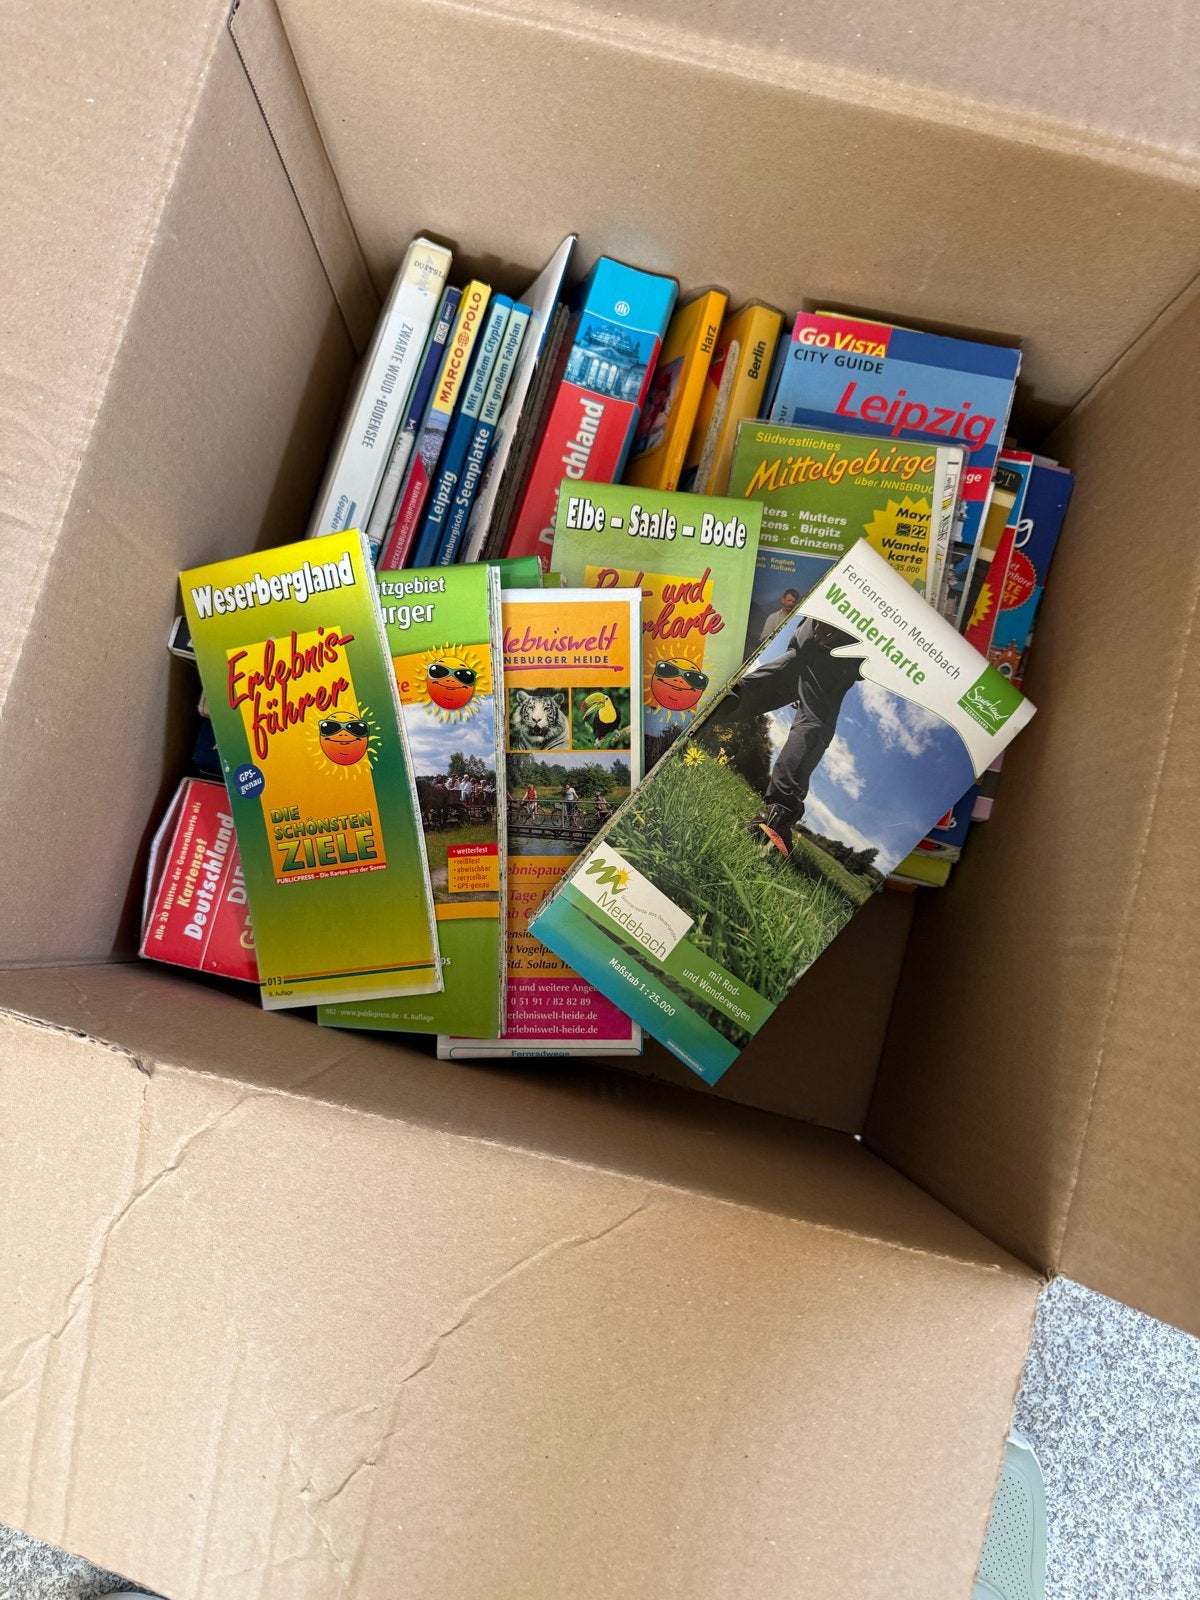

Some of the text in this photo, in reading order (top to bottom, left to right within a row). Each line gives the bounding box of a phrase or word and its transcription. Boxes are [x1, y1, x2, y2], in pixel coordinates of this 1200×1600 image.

[440, 344, 464, 403] MARCO
[461, 291, 483, 335] POLO
[700, 324, 718, 354] Harz
[832, 334, 887, 359] VISTA
[464, 314, 505, 412] Mit großem Cityplan
[484, 322, 523, 420] Mit großem Faltplan
[747, 340, 767, 380] Berlin
[793, 348, 885, 375] CITY GUIDE
[361, 323, 414, 449] ZWARTE WOUD BODENSEE
[834, 381, 997, 453] Leipzig
[755, 431, 842, 452] Südwestliches
[744, 446, 937, 499] Mittelgebirge
[854, 476, 936, 495] über INNSBRUC
[427, 471, 458, 524] Leipzig
[440, 428, 491, 566] klenburgische Seenplatte
[330, 494, 351, 532] Gouden
[389, 480, 424, 571] MECKLENBURG-VORPOMMERN
[566, 497, 606, 532] Elbe
[627, 504, 677, 540] Saale
[700, 512, 747, 549] Bode
[763, 505, 848, 526] ters Mutters
[761, 520, 842, 538] zens Birgitz
[789, 535, 845, 552] Grinzens
[910, 525, 929, 540] 22
[887, 550, 925, 566] karte
[889, 563, 921, 574] :35.000
[190, 551, 356, 620] Weserbergland
[661, 566, 712, 606] und
[642, 601, 726, 641] rkarte
[824, 582, 928, 687] Wanderkarte
[841, 563, 962, 682] Ferienregion Medebach
[504, 622, 618, 654] lebniswelt
[226, 626, 354, 710] Erlebnis-
[504, 654, 609, 664] NEBURGER HEIDE
[252, 676, 350, 760] führer
[239, 769, 257, 783] GPS-
[240, 777, 263, 795] genau
[270, 805, 301, 824] DIE
[274, 811, 373, 841] SCHÖNSTEN
[176, 816, 198, 866] Generalkarte
[276, 828, 378, 873] ZIELE
[456, 846, 488, 856] wetterfest
[170, 863, 184, 881] der
[176, 838, 208, 908] Kartenset
[184, 812, 235, 941] Deutschland
[276, 874, 315, 885] PUBLICPRESS
[330, 868, 350, 878] Karten
[370, 862, 388, 872] Sonne
[456, 866, 491, 875] abwischbar
[507, 863, 567, 879] ebnispaus
[163, 882, 178, 911] Blätter
[457, 882, 491, 890] GPS-genau
[510, 889, 537, 904] Tage
[154, 926, 168, 941] Alle
[597, 891, 667, 959] Medebach
[526, 959, 558, 969] Soltau
[267, 976, 283, 987] 013
[518, 983, 536, 992] und
[537, 983, 570, 992] weitere
[609, 957, 640, 988] Maßstab
[648, 991, 676, 1017] 25.000
[682, 968, 751, 1022] und Wanderwegen
[708, 970, 740, 996] mit Rad-
[507, 1010, 598, 1020] erlebniswelt-heide.de
[519, 997, 529, 1006] 51
[532, 997, 543, 1006] 91
[552, 997, 564, 1006] 82
[566, 997, 578, 1006] 82
[580, 997, 591, 1006] 89
[410, 1013, 434, 1022] Auflage
